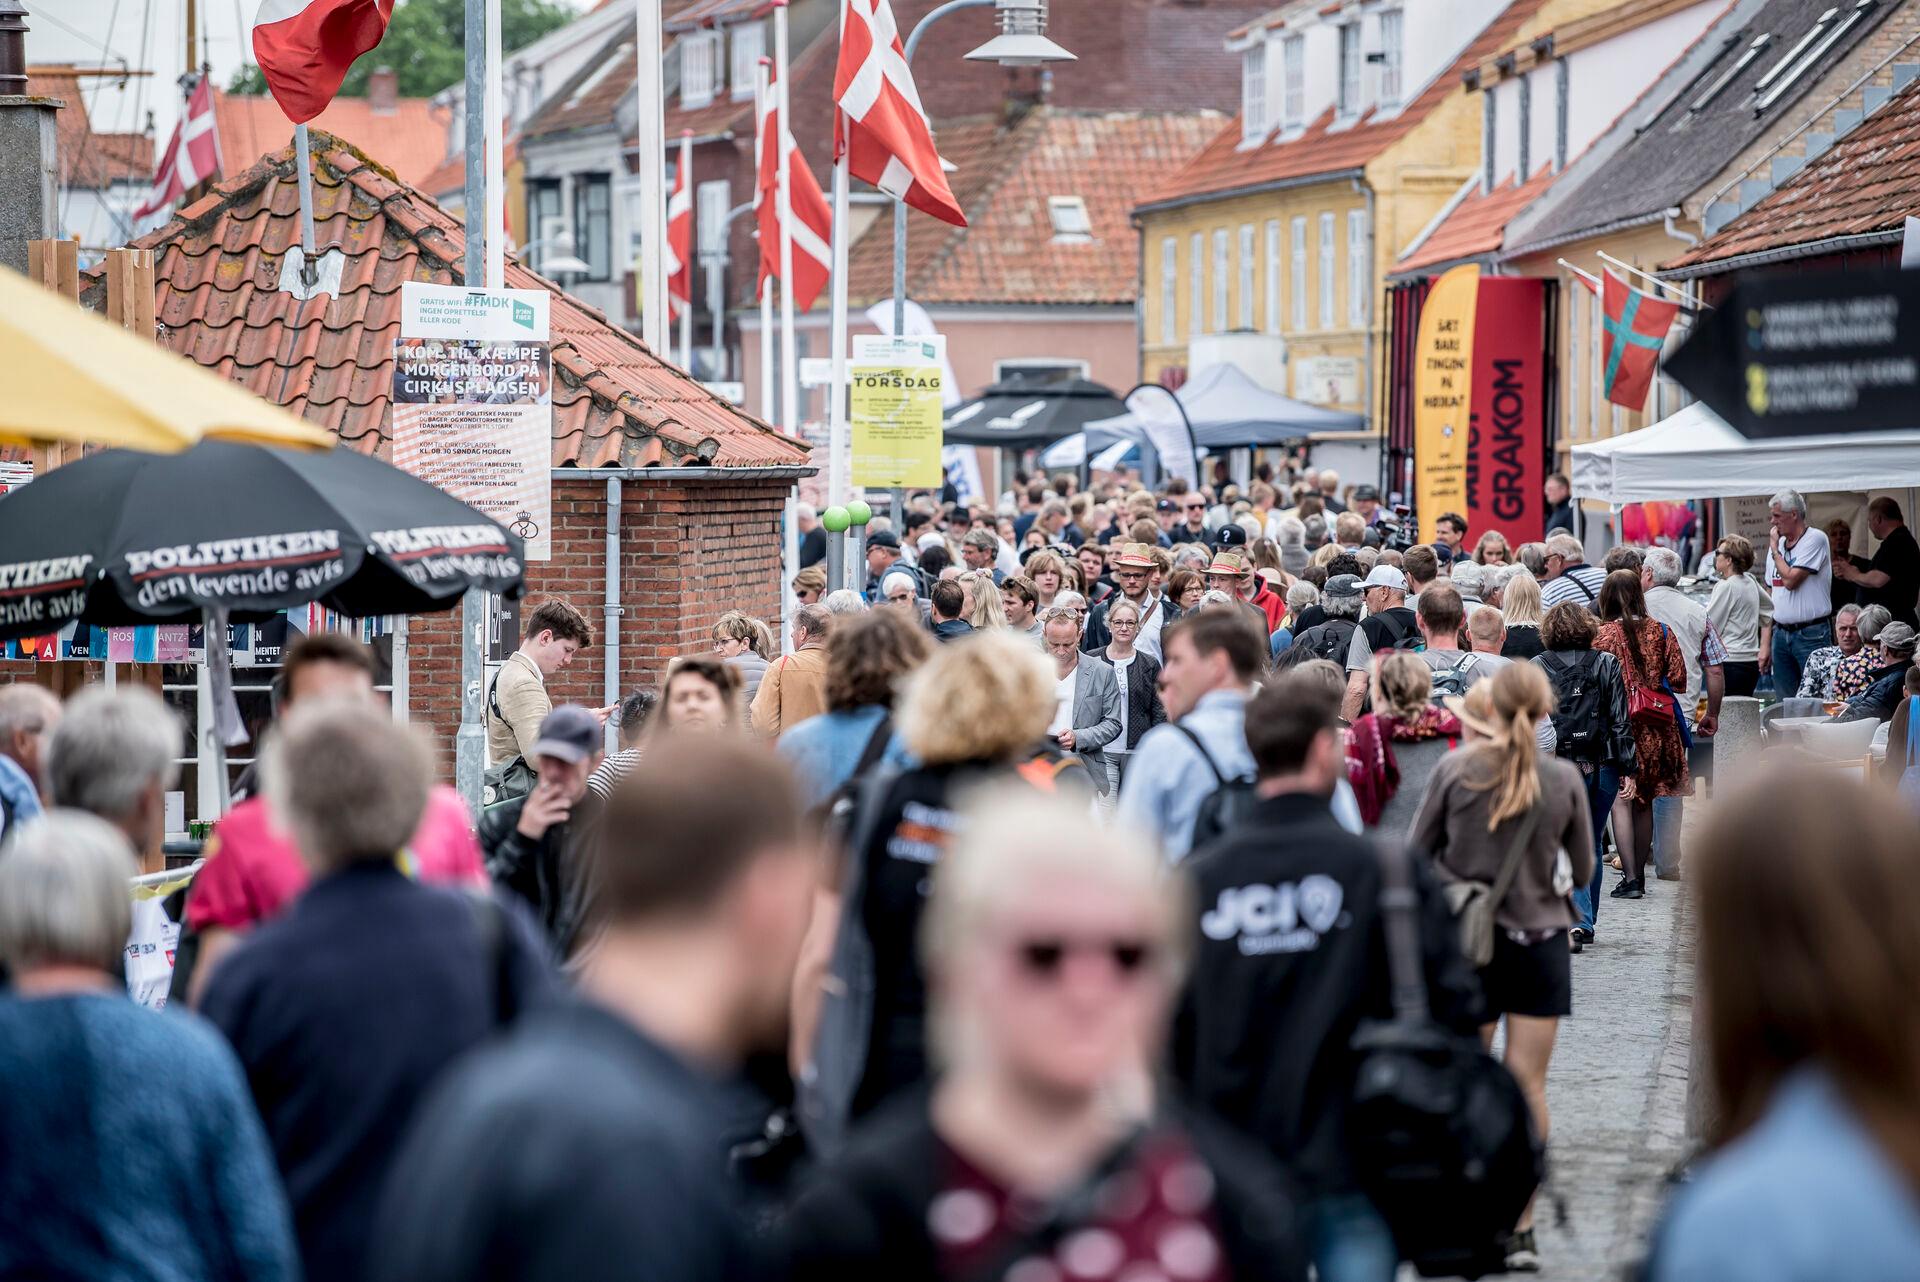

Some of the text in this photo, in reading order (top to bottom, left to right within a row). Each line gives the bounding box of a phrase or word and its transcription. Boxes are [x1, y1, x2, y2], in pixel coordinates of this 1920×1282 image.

[420, 298, 445, 306] GRATIS
[464, 295, 509, 308] #FMDK
[419, 307, 488, 317] INGEN OPRETTELSE
[419, 316, 461, 325] ELLER KODE
[447, 347, 472, 360] TIL
[480, 347, 540, 361] KÆMPE
[405, 361, 540, 378] MORGENBORD PÅ
[404, 380, 540, 396] CIRKUSPLADSEN
[853, 377, 940, 388] TORSDAG
[1491, 358, 1525, 521] GRAKOM
[124, 529, 340, 576] POLITIKEN
[137, 559, 345, 608] den levende avis
[43, 642, 54, 658] A
[70, 645, 89, 655] VEN
